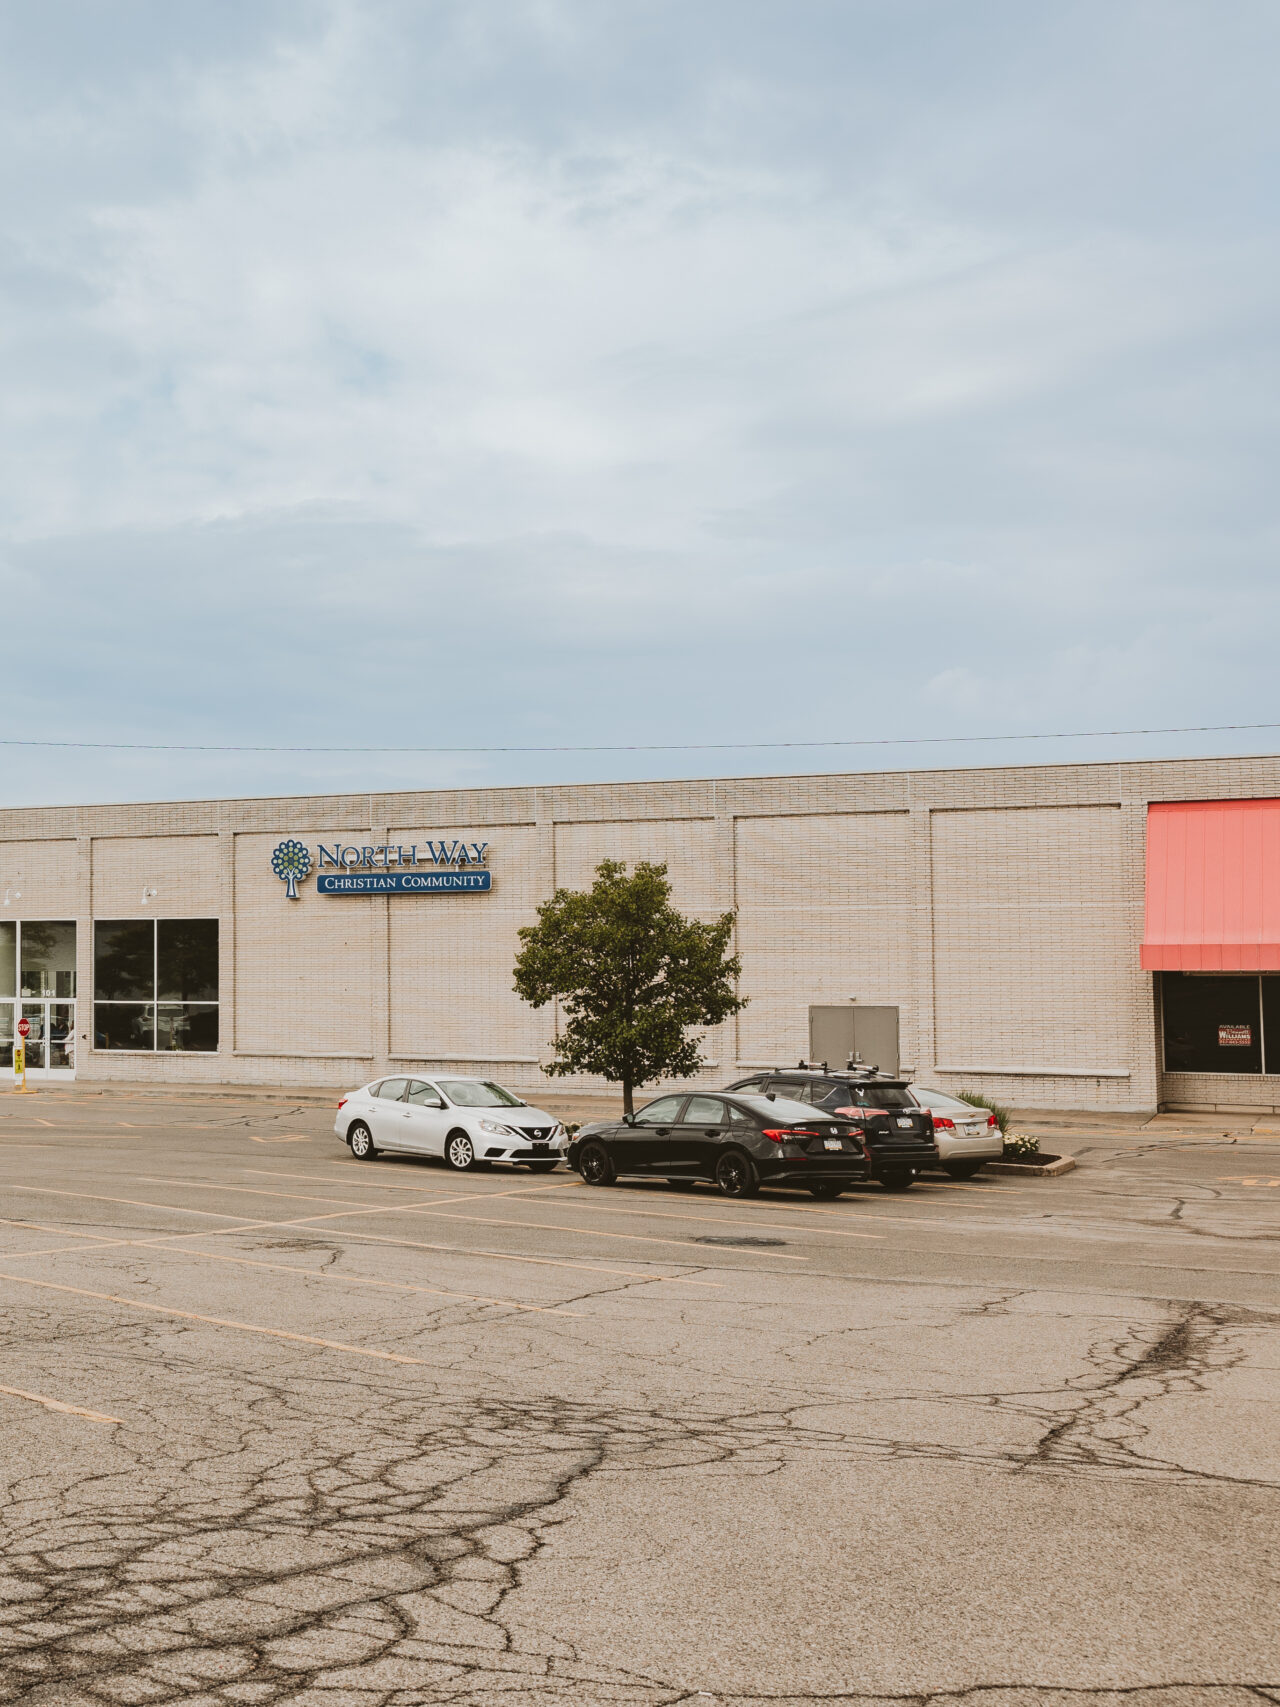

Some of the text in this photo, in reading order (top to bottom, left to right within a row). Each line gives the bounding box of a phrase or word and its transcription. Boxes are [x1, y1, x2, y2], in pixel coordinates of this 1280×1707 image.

[317, 840, 488, 868] NORTH WAY
[325, 875, 485, 889] CHRISTIAN COMMUNITY
[18, 1023, 29, 1031] STOP
